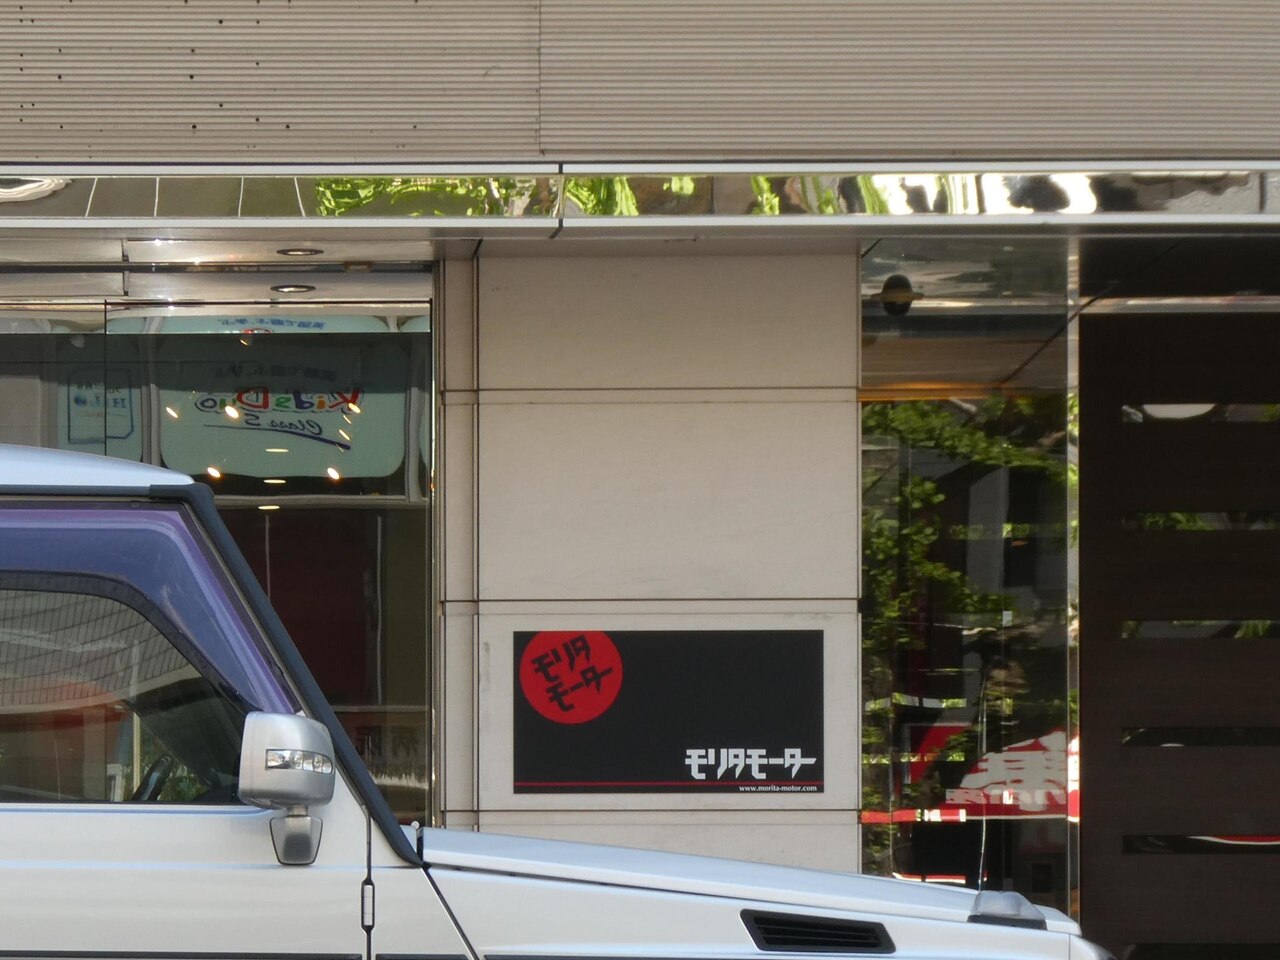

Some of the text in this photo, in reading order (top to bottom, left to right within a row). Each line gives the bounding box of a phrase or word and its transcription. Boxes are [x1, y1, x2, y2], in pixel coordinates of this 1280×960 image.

[531, 634, 592, 683] モリタ
[545, 665, 613, 712] モーター
[684, 747, 817, 780] モリタモーター
[738, 784, 818, 792] www.morita-motor.com
